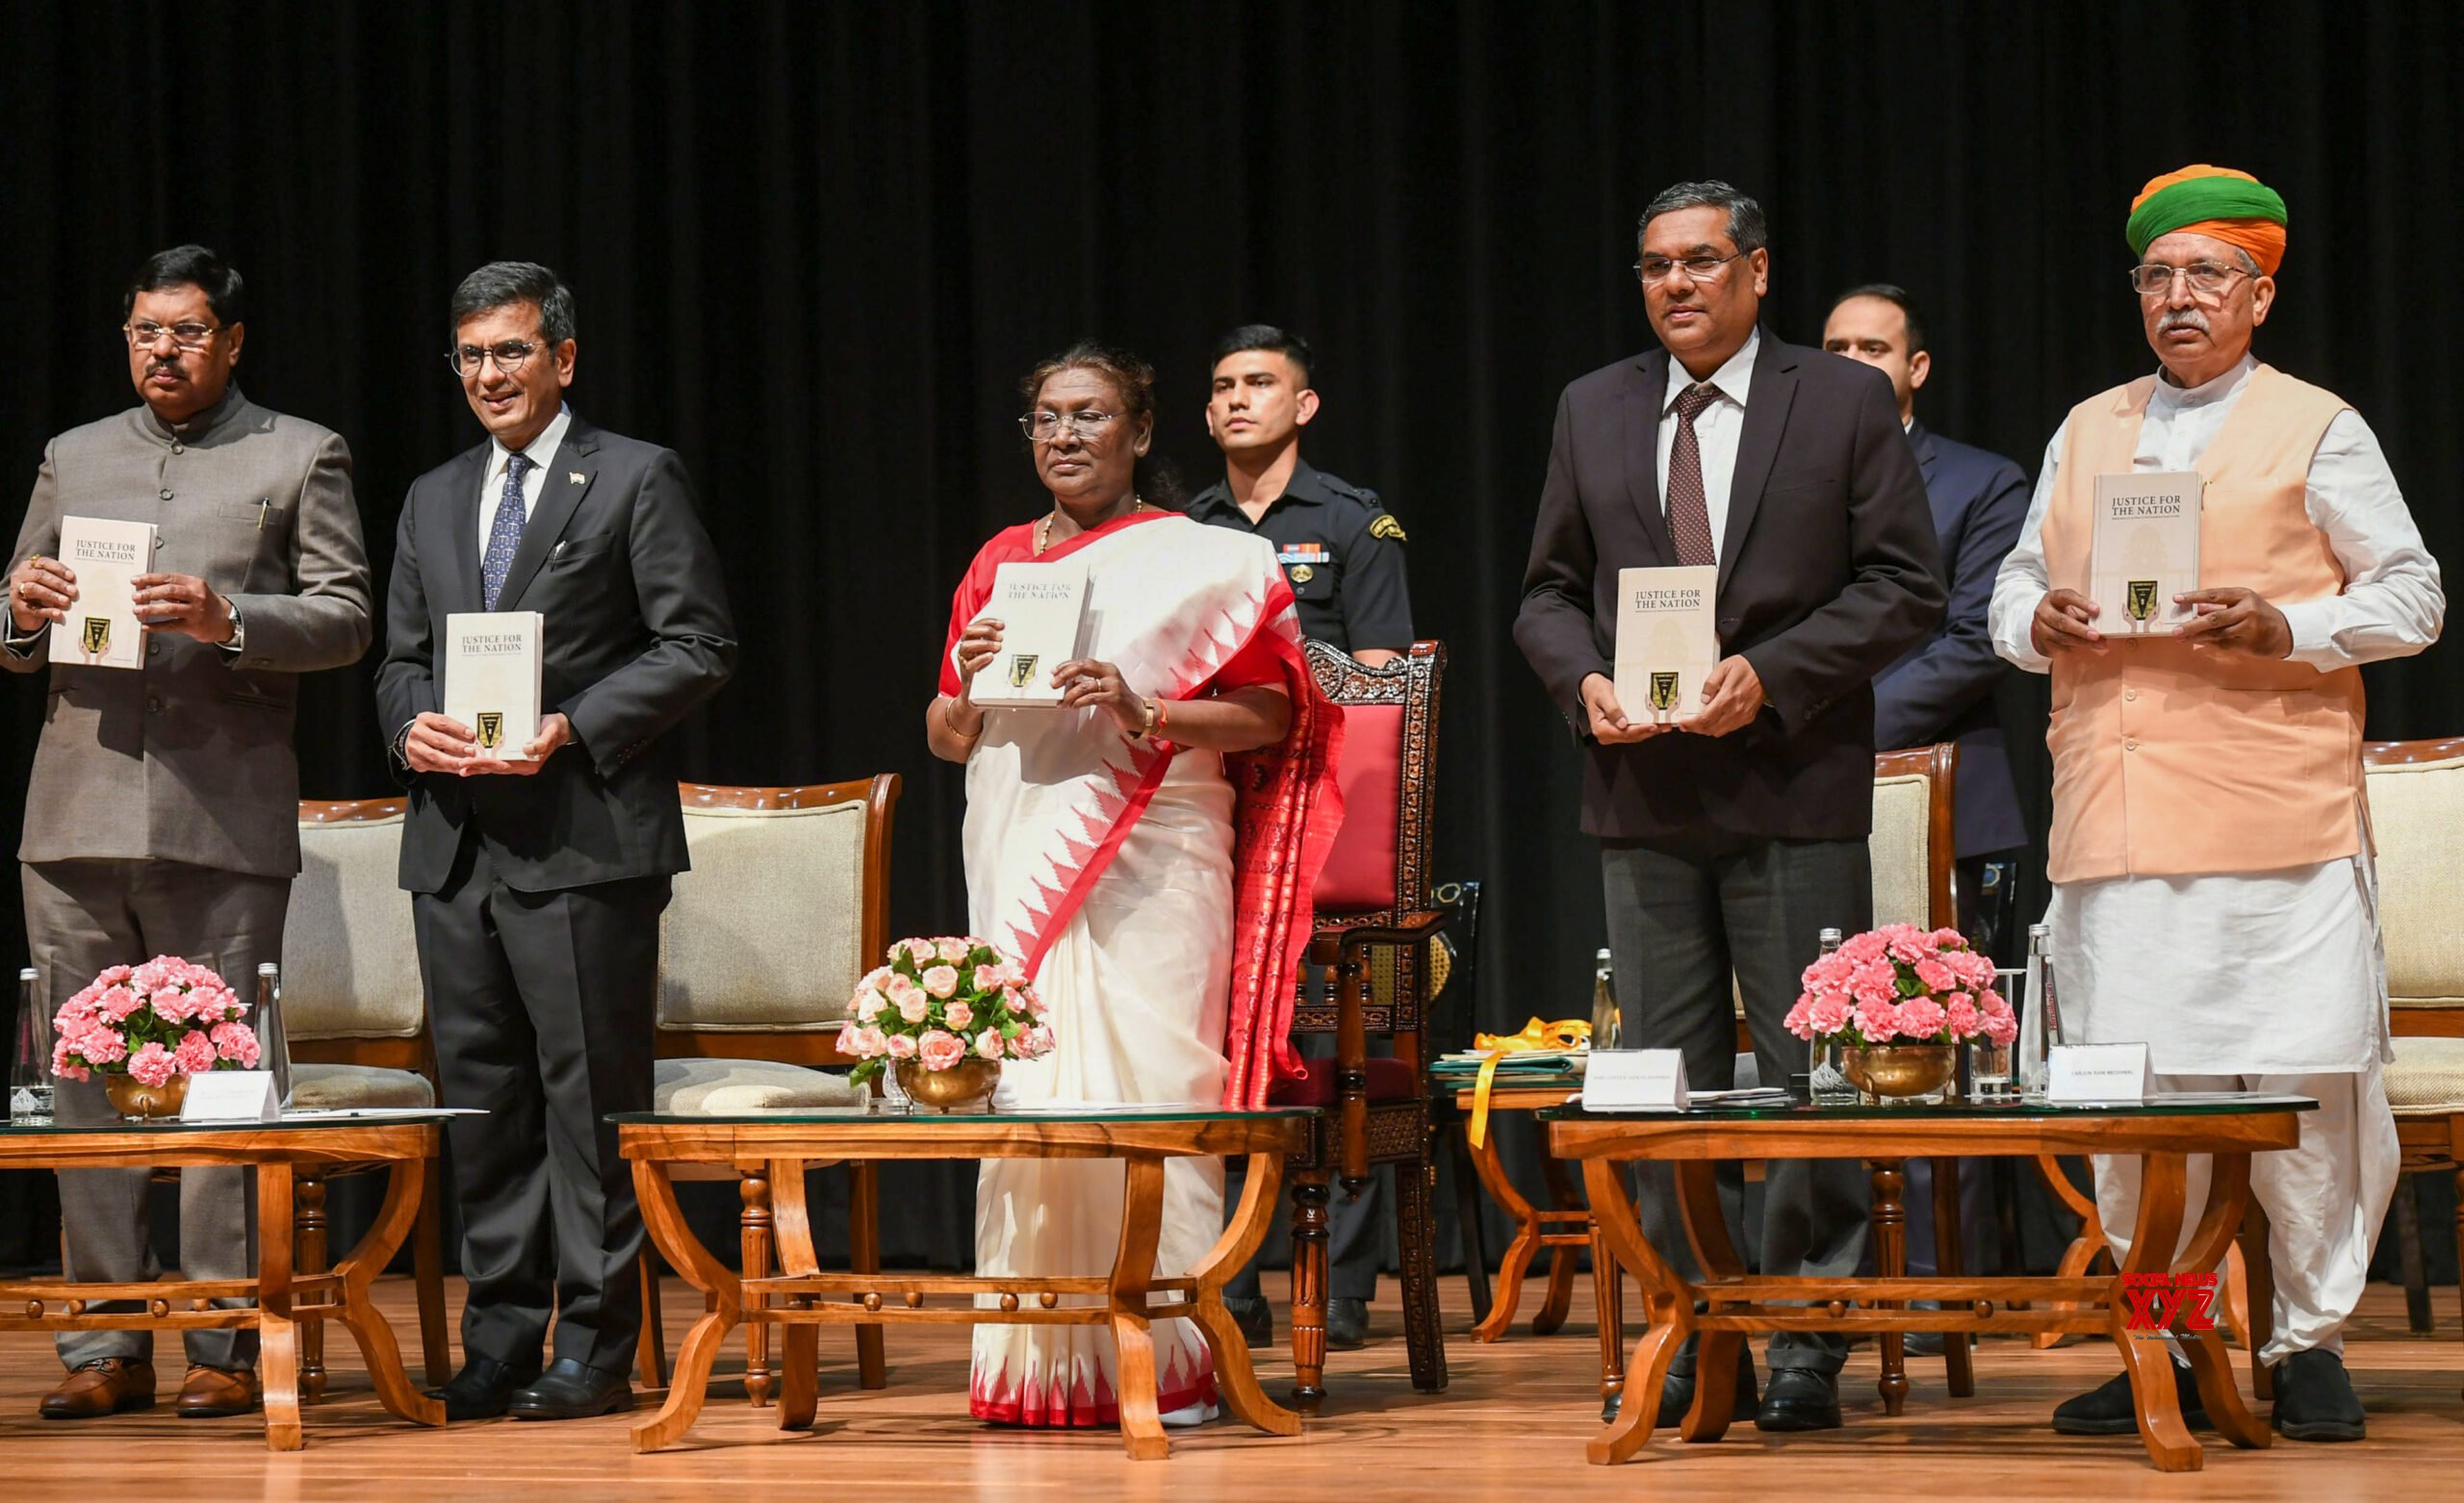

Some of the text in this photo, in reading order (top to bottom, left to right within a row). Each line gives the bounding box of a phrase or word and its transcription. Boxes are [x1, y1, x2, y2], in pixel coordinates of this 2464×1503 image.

[2112, 496, 2181, 507] JUSTICE FOR
[2112, 505, 2181, 516] THE NATION
[76, 539, 136, 552] JUSTICE FOR
[76, 548, 135, 560] THE NATION
[1635, 589, 1701, 600] JUSTICE FOR
[1635, 599, 1701, 609] THE NATION
[462, 634, 522, 645] JUSTICE FOR
[462, 643, 522, 652] THE NATION
